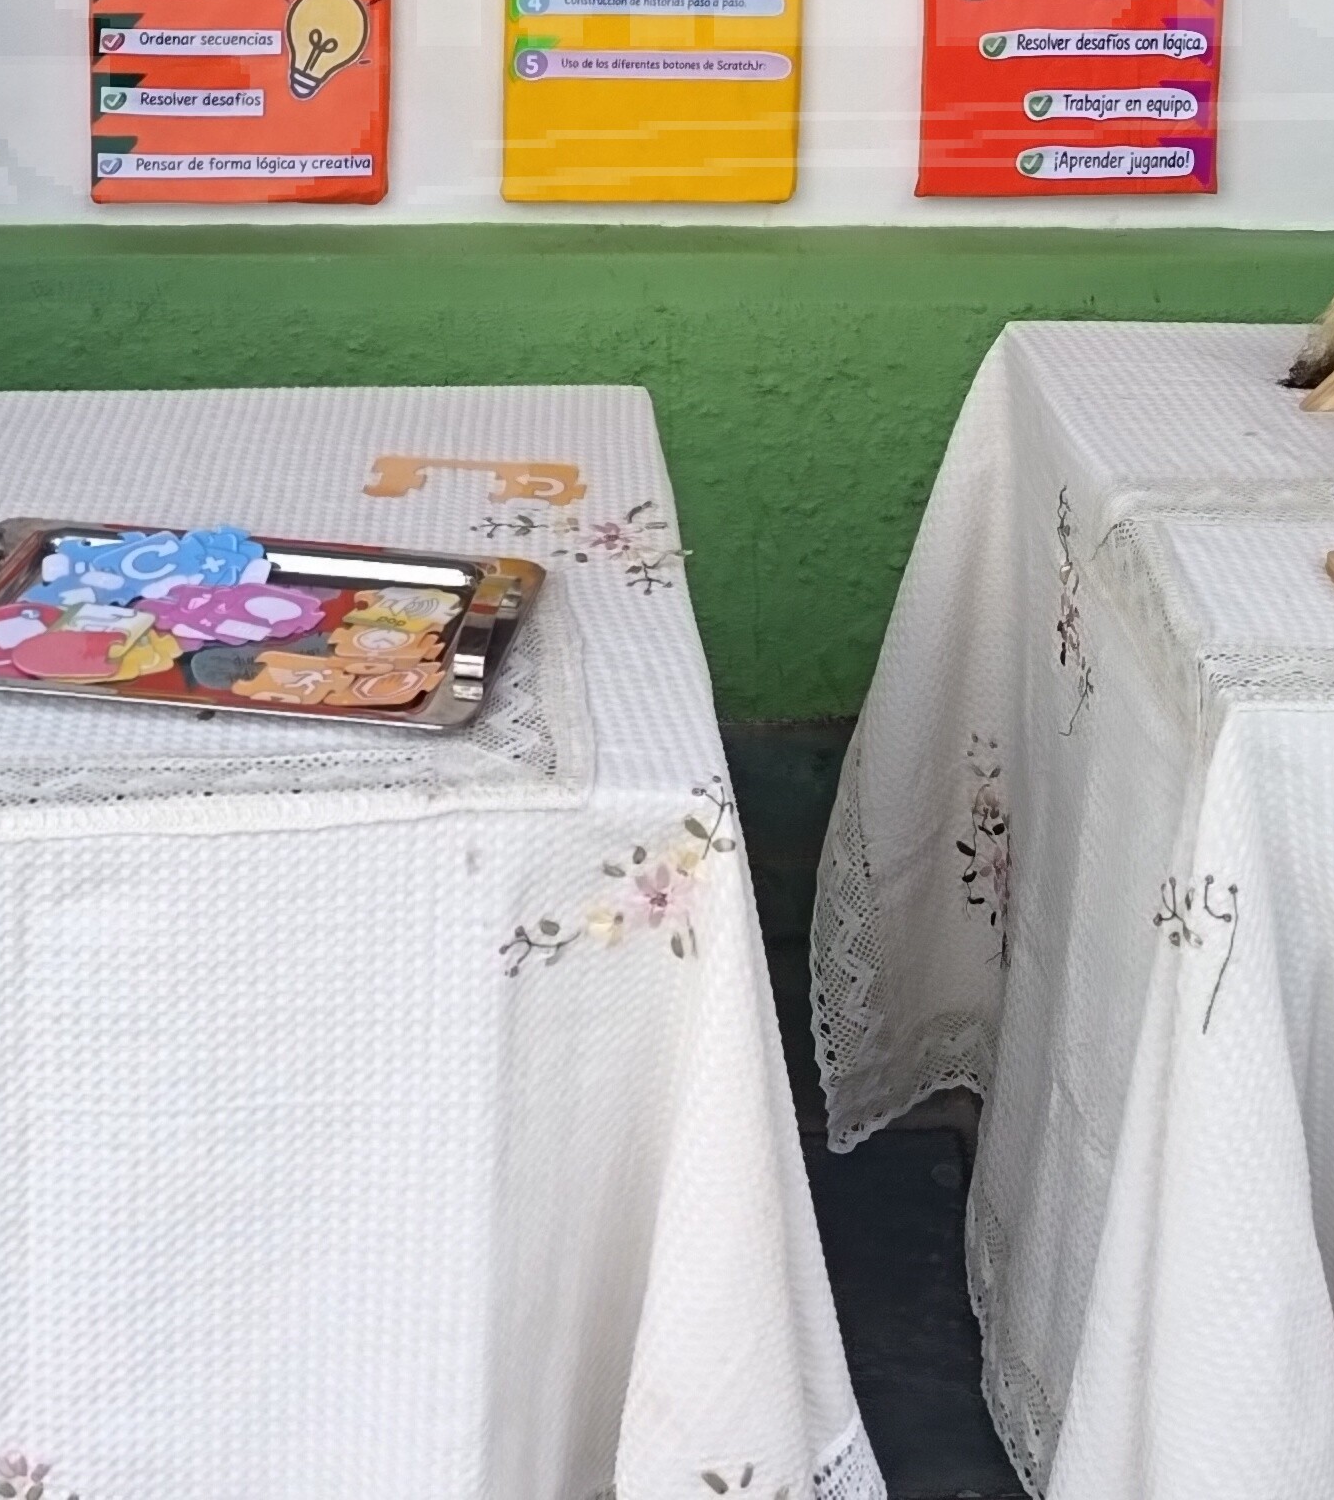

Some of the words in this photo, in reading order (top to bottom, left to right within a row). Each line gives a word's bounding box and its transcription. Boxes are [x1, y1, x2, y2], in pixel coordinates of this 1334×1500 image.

[139, 32, 195, 46] Ordenar
[199, 34, 273, 46] secuencias
[1017, 34, 1071, 51] Resolver
[1076, 34, 1132, 51] desafíos
[1136, 38, 1159, 51] con
[1163, 34, 1204, 56] lógica.
[525, 55, 539, 73] 5
[561, 58, 579, 69] Uso
[582, 59, 593, 69] de
[596, 59, 609, 70] los
[611, 58, 660, 71] diferentes
[663, 60, 700, 71] botones
[703, 60, 715, 71] de
[140, 92, 198, 106] Resolver
[202, 92, 261, 106] desafíos
[1063, 95, 1121, 115] Trabajar
[1125, 98, 1141, 111] en
[1147, 96, 1194, 117] equipo.
[136, 158, 184, 171] Pensar
[188, 158, 205, 171] de
[209, 156, 252, 172] forma
[256, 156, 296, 172] lógica
[299, 159, 308, 172] y
[312, 157, 371, 170] creativa
[1054, 152, 1124, 172] ¡Aprender
[1127, 151, 1190, 175] jugando!
[377, 616, 406, 627] pop
